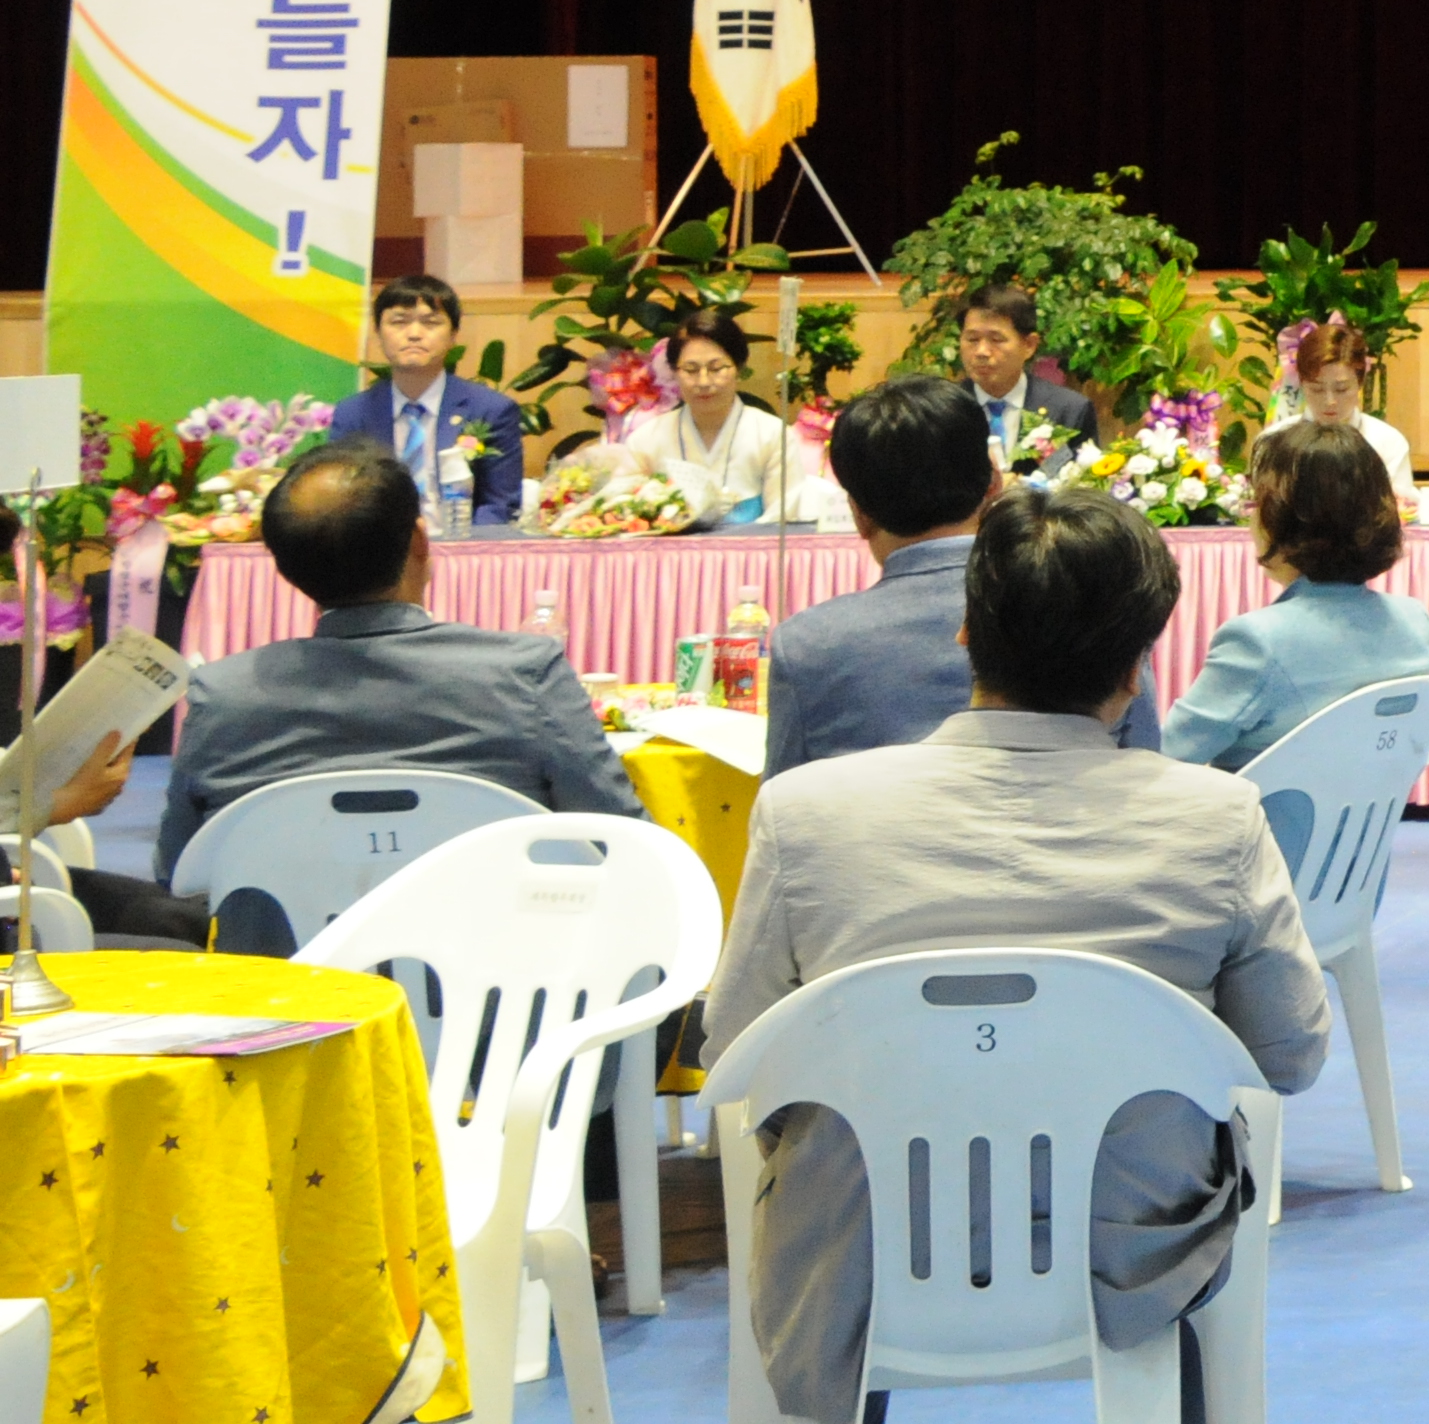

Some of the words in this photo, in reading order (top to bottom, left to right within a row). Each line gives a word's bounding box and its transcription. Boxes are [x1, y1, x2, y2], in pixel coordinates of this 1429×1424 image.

[1375, 730, 1398, 752] 58
[369, 830, 401, 854] 11
[975, 1023, 997, 1053] 3
